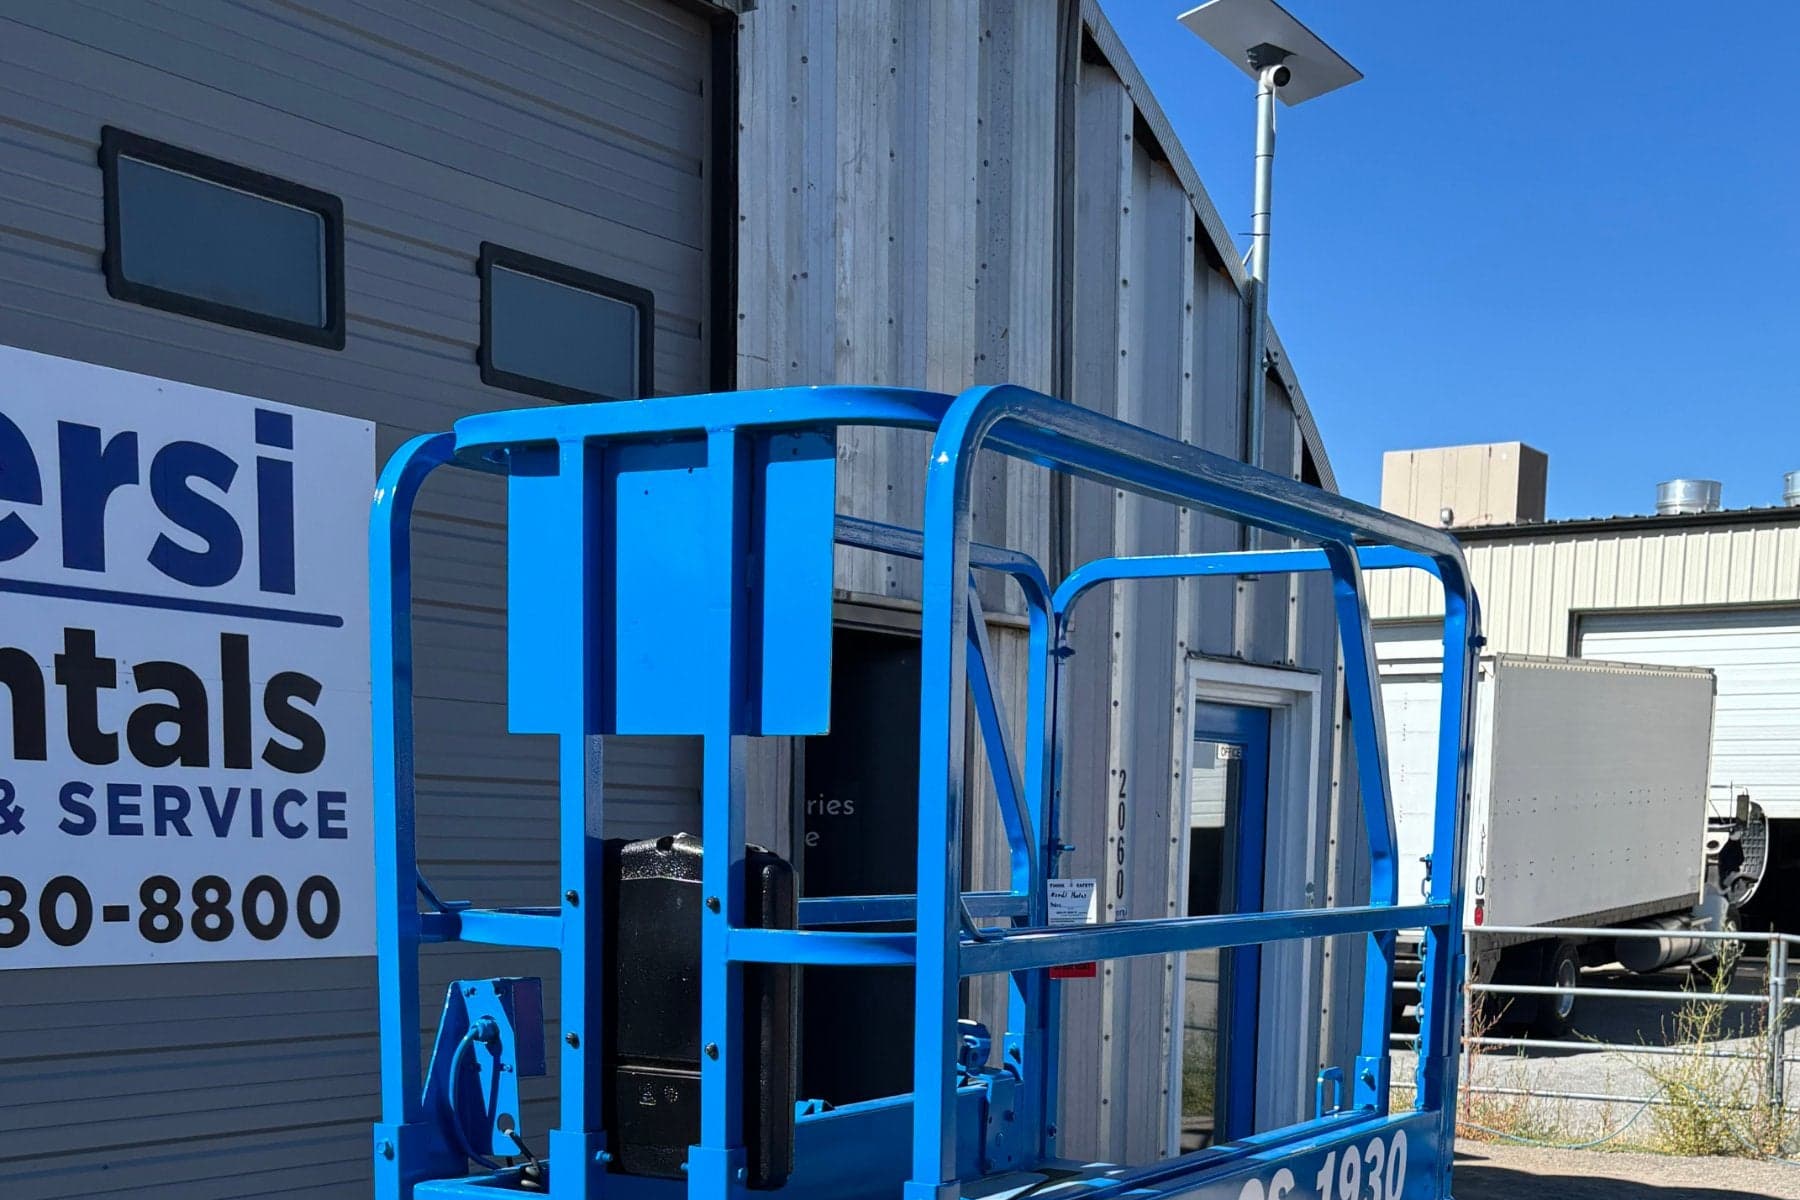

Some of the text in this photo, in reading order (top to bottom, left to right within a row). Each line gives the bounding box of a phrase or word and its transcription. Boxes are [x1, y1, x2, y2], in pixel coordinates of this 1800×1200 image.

[58, 781, 348, 839] SERVICE
[807, 793, 855, 815] ries
[1116, 768, 1127, 899] 2060
